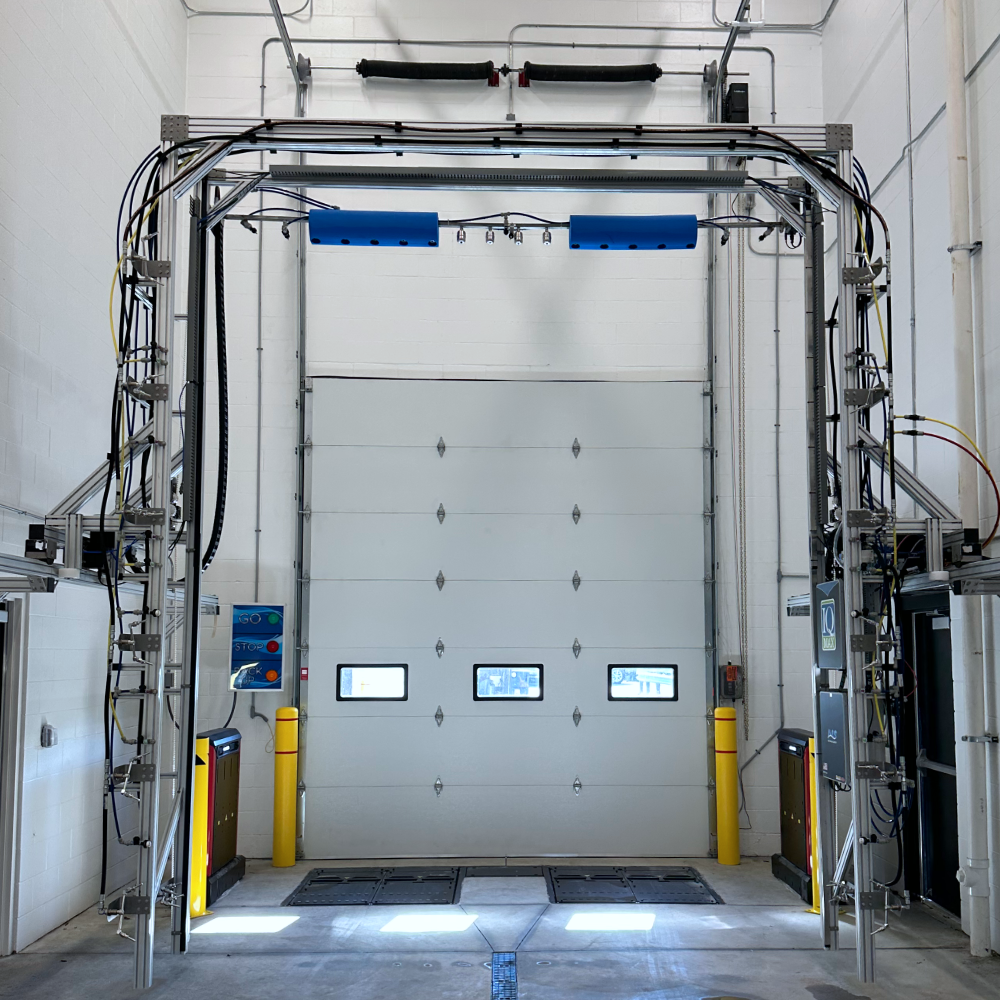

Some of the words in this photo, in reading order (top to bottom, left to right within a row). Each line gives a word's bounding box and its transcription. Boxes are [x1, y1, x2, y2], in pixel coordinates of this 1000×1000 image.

[239, 613, 261, 624] GO
[822, 606, 835, 636] IQ
[235, 643, 264, 651] STOP
